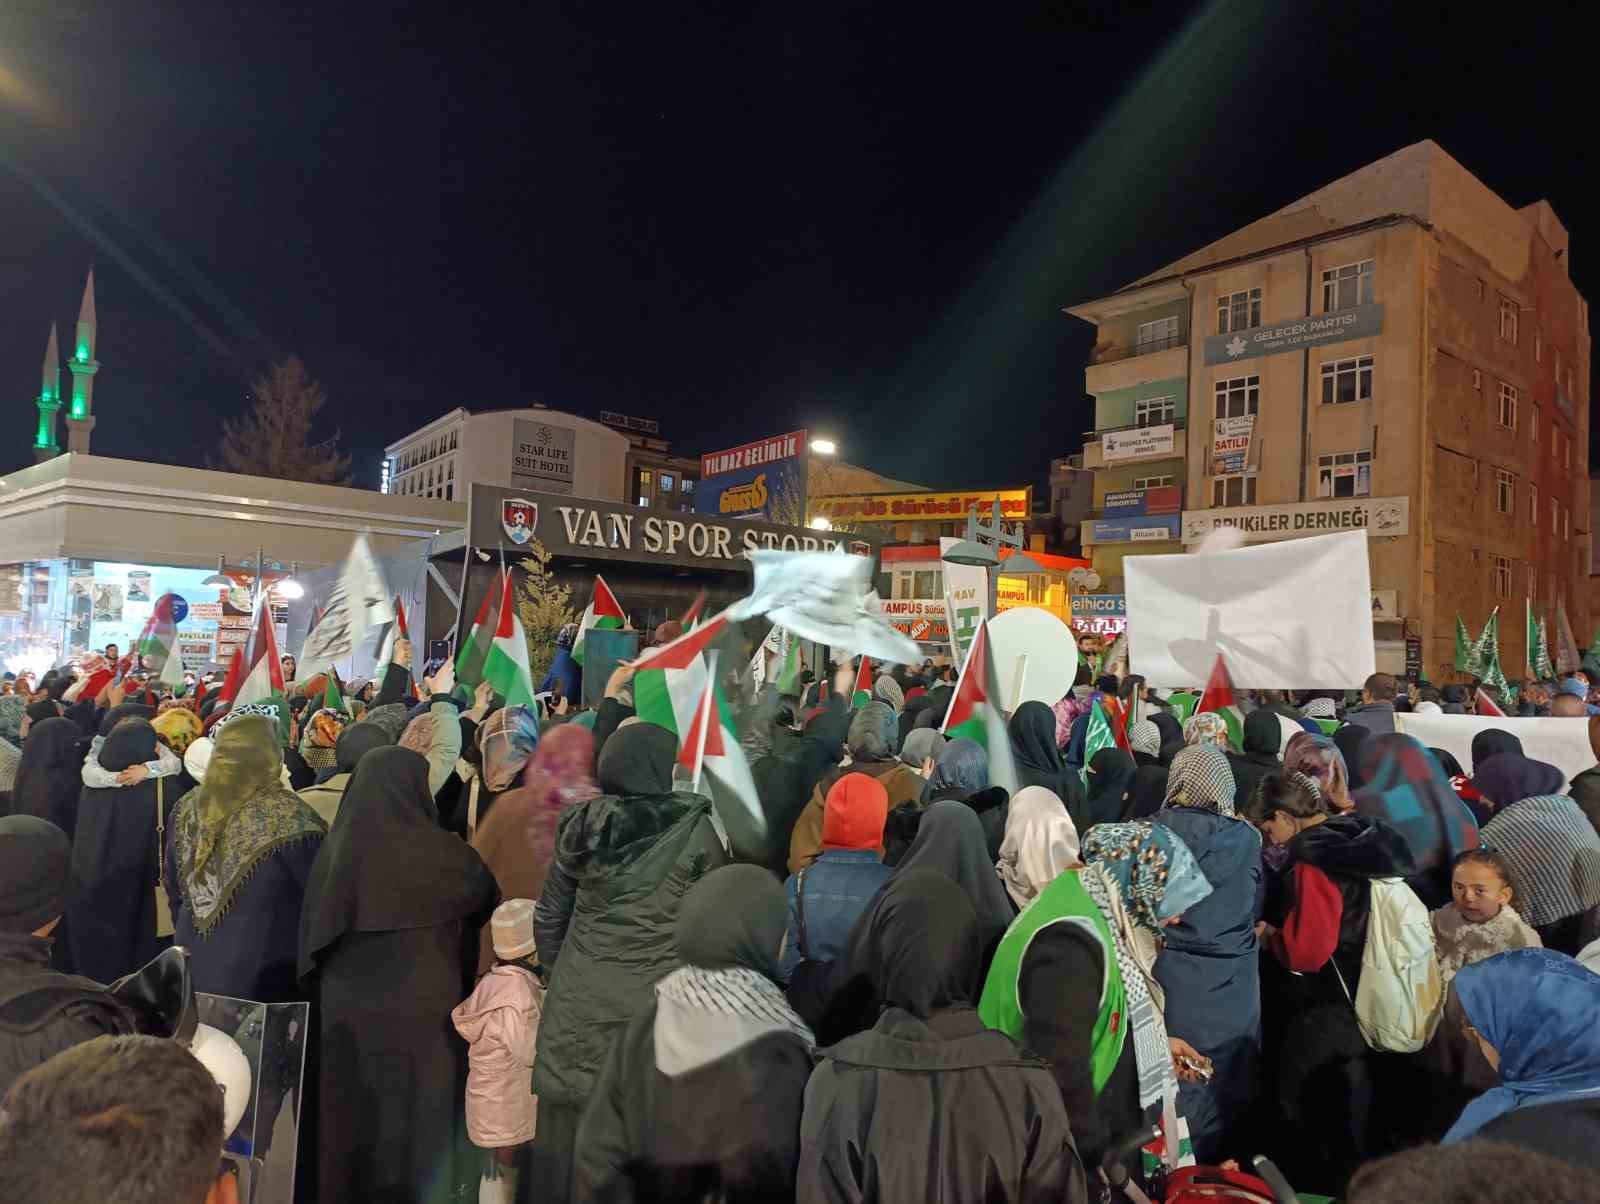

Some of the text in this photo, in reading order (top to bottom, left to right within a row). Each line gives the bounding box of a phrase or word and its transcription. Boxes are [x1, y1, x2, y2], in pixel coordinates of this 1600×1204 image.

[1253, 324, 1306, 343] GELECEK
[519, 443, 569, 461] STAR LIFE
[540, 460, 569, 474] HOTEL
[705, 451, 745, 476] YILMAZ
[558, 506, 634, 550] VAN
[643, 516, 734, 560] SPOR
